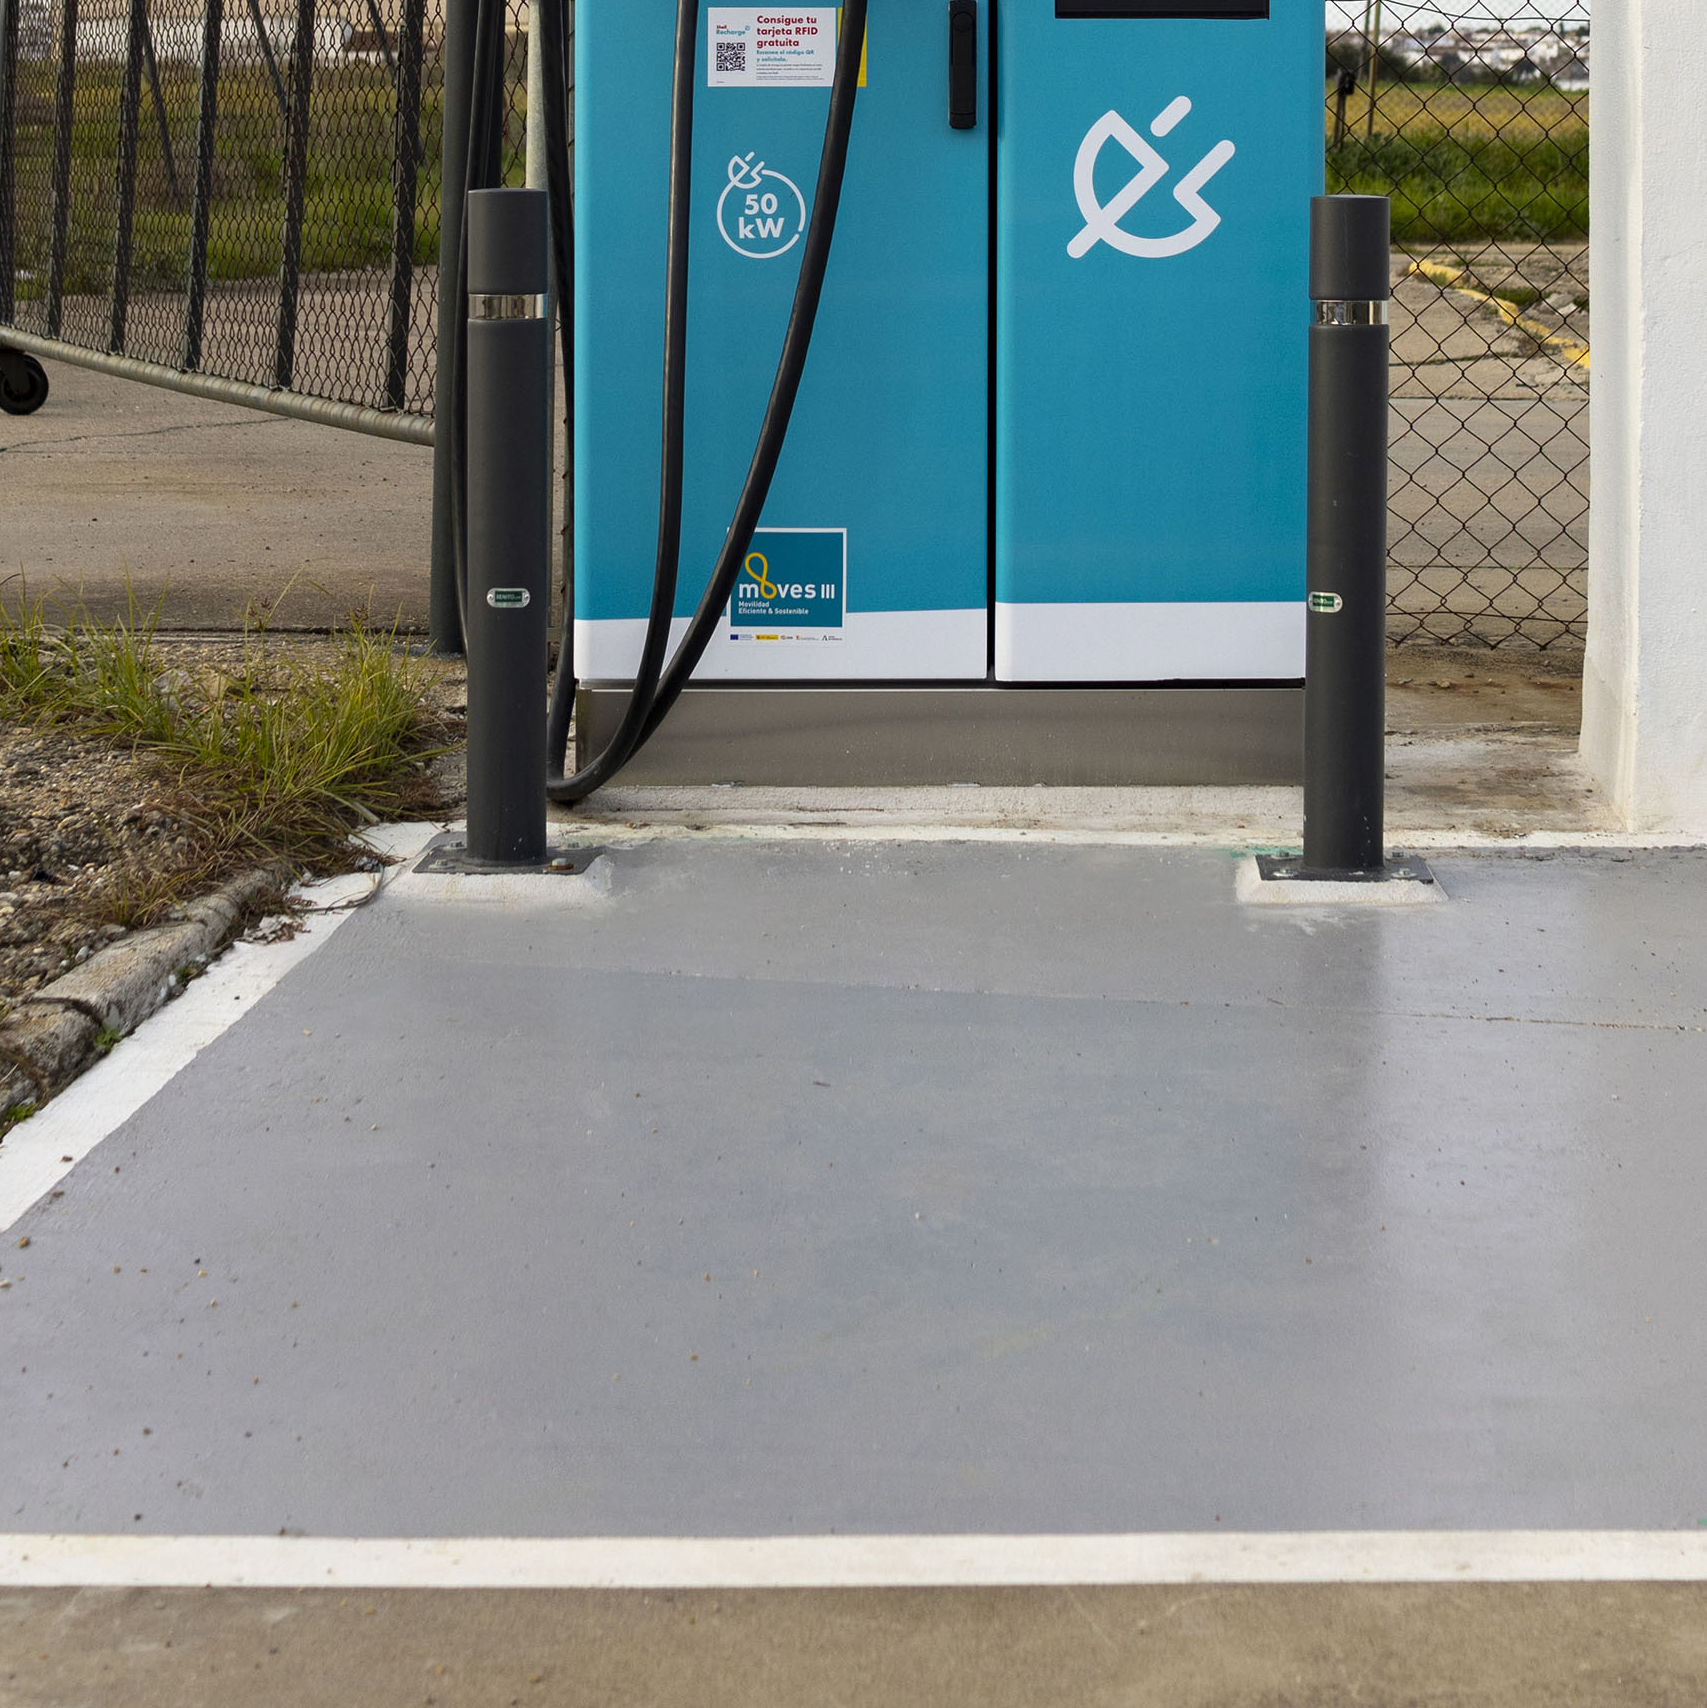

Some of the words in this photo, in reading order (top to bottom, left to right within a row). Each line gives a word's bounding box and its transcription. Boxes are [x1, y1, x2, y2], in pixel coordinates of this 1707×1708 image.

[756, 15, 804, 26] Consigue
[806, 15, 817, 24] tu
[756, 26, 792, 37] tarjeta
[794, 27, 818, 35] RFID
[756, 38, 800, 49] gratuita
[744, 193, 778, 215] 50
[738, 217, 785, 239] kW
[820, 584, 835, 599] III
[738, 600, 770, 608] Movilidad
[738, 607, 767, 615] Eficiente
[768, 607, 774, 615] &
[774, 607, 809, 615] Sostenible
